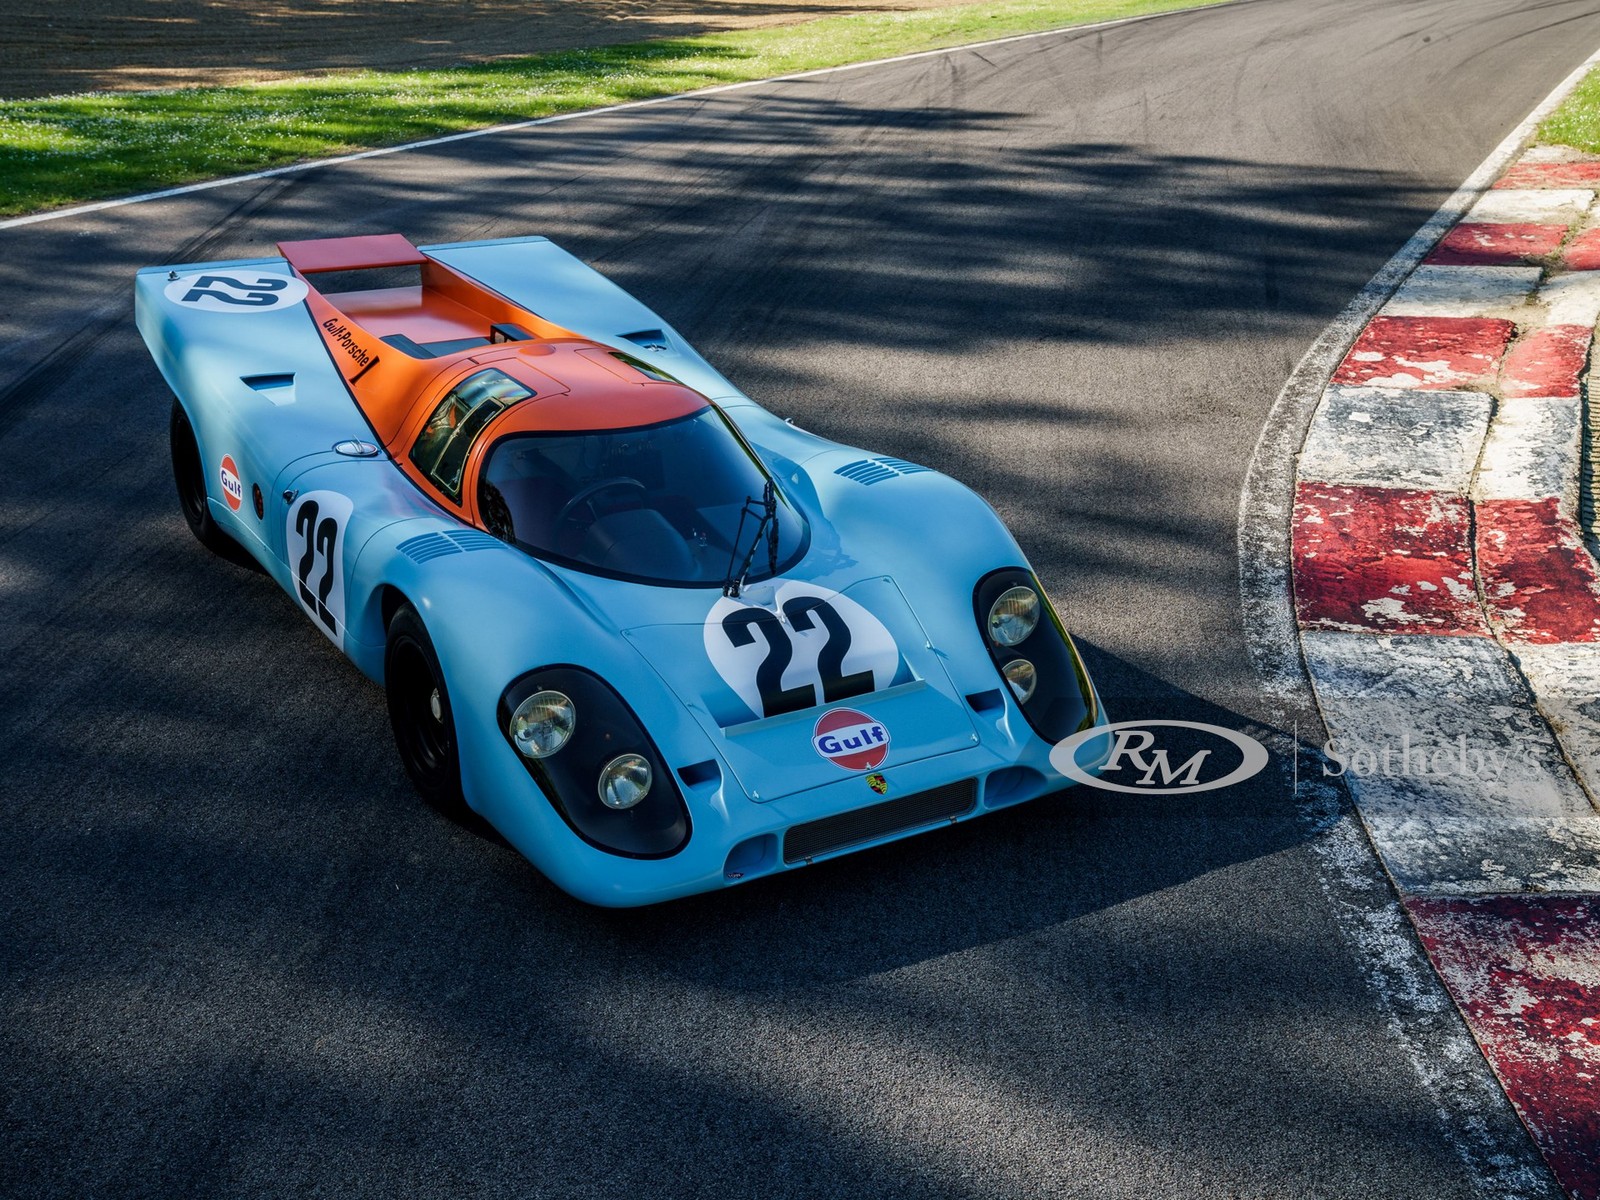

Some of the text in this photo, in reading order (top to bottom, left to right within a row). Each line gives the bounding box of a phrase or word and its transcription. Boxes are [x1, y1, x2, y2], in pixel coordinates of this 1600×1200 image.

[181, 275, 288, 306] 22
[221, 470, 242, 497] Gulf
[296, 500, 338, 637] 22
[722, 596, 876, 718] 22
[818, 726, 884, 754] Gulf
